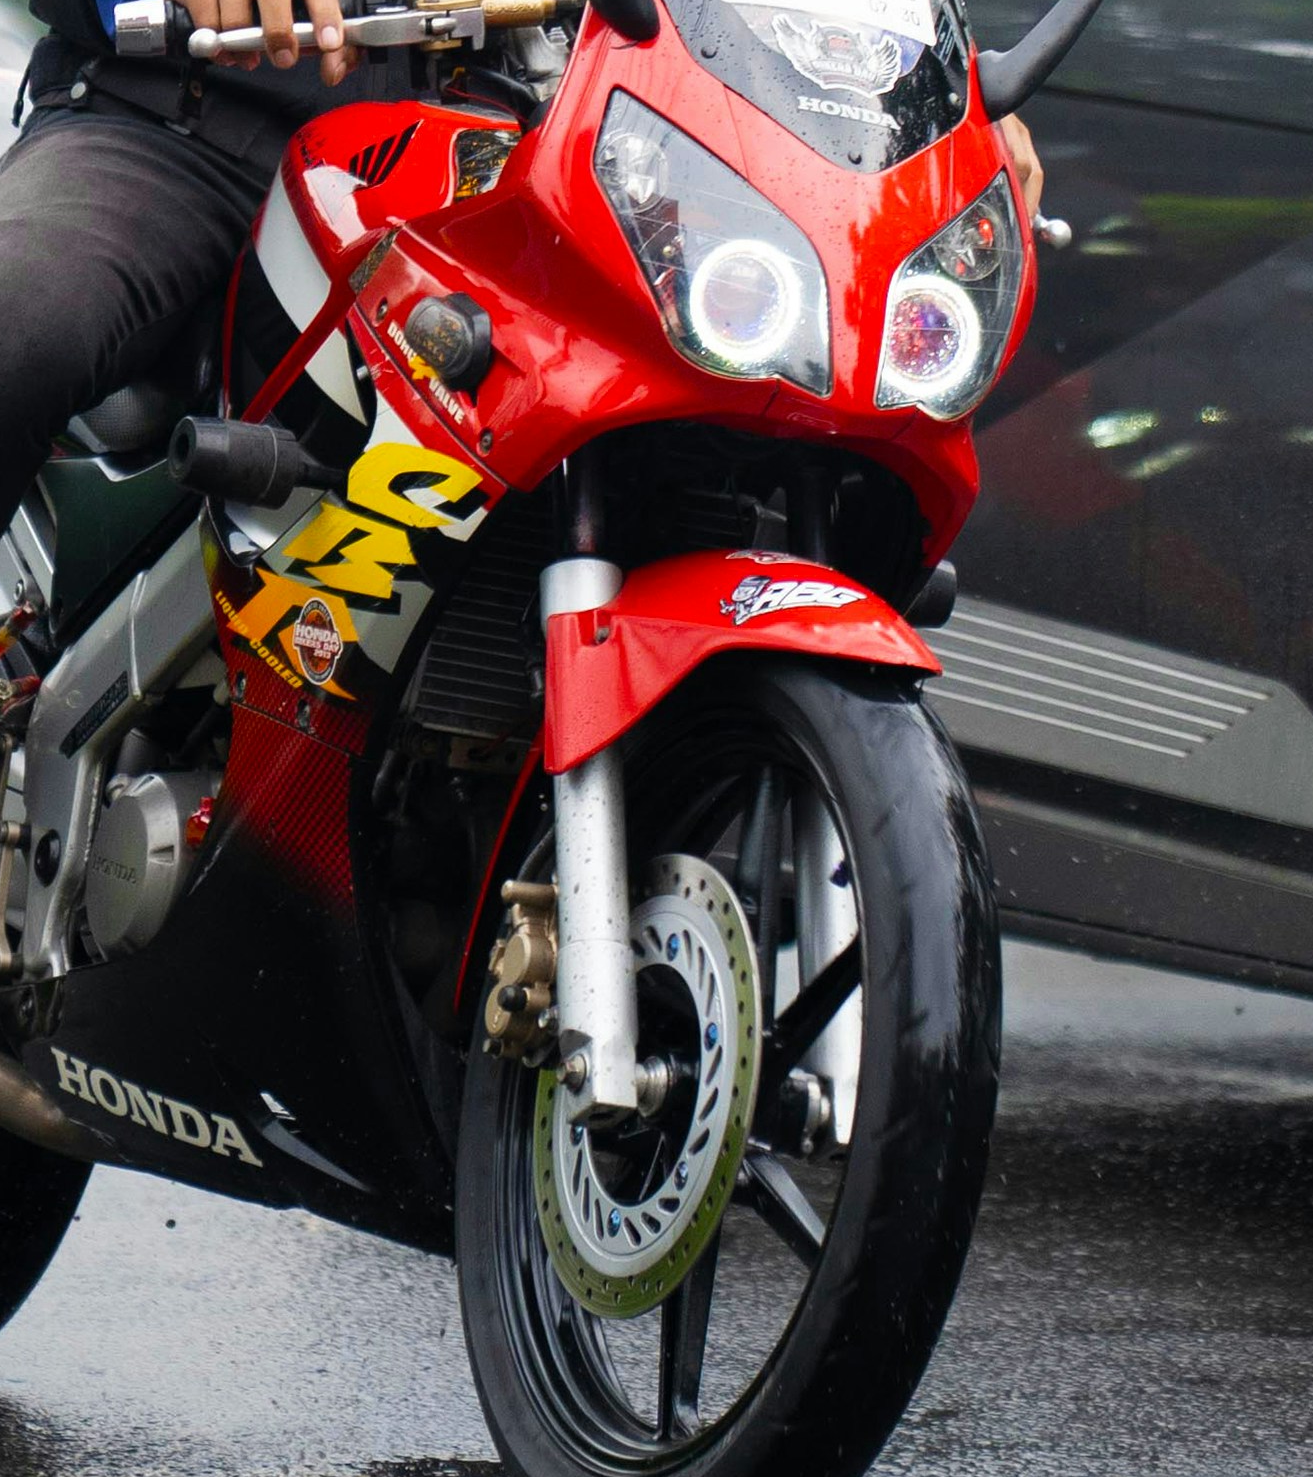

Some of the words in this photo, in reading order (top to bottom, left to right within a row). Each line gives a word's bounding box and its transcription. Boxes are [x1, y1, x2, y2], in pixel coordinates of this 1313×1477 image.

[796, 96, 903, 131] HONDA
[429, 376, 466, 425] VALVE
[295, 624, 338, 642] HONDA
[249, 638, 303, 689] COOLED
[51, 1046, 264, 1168] HONDA
